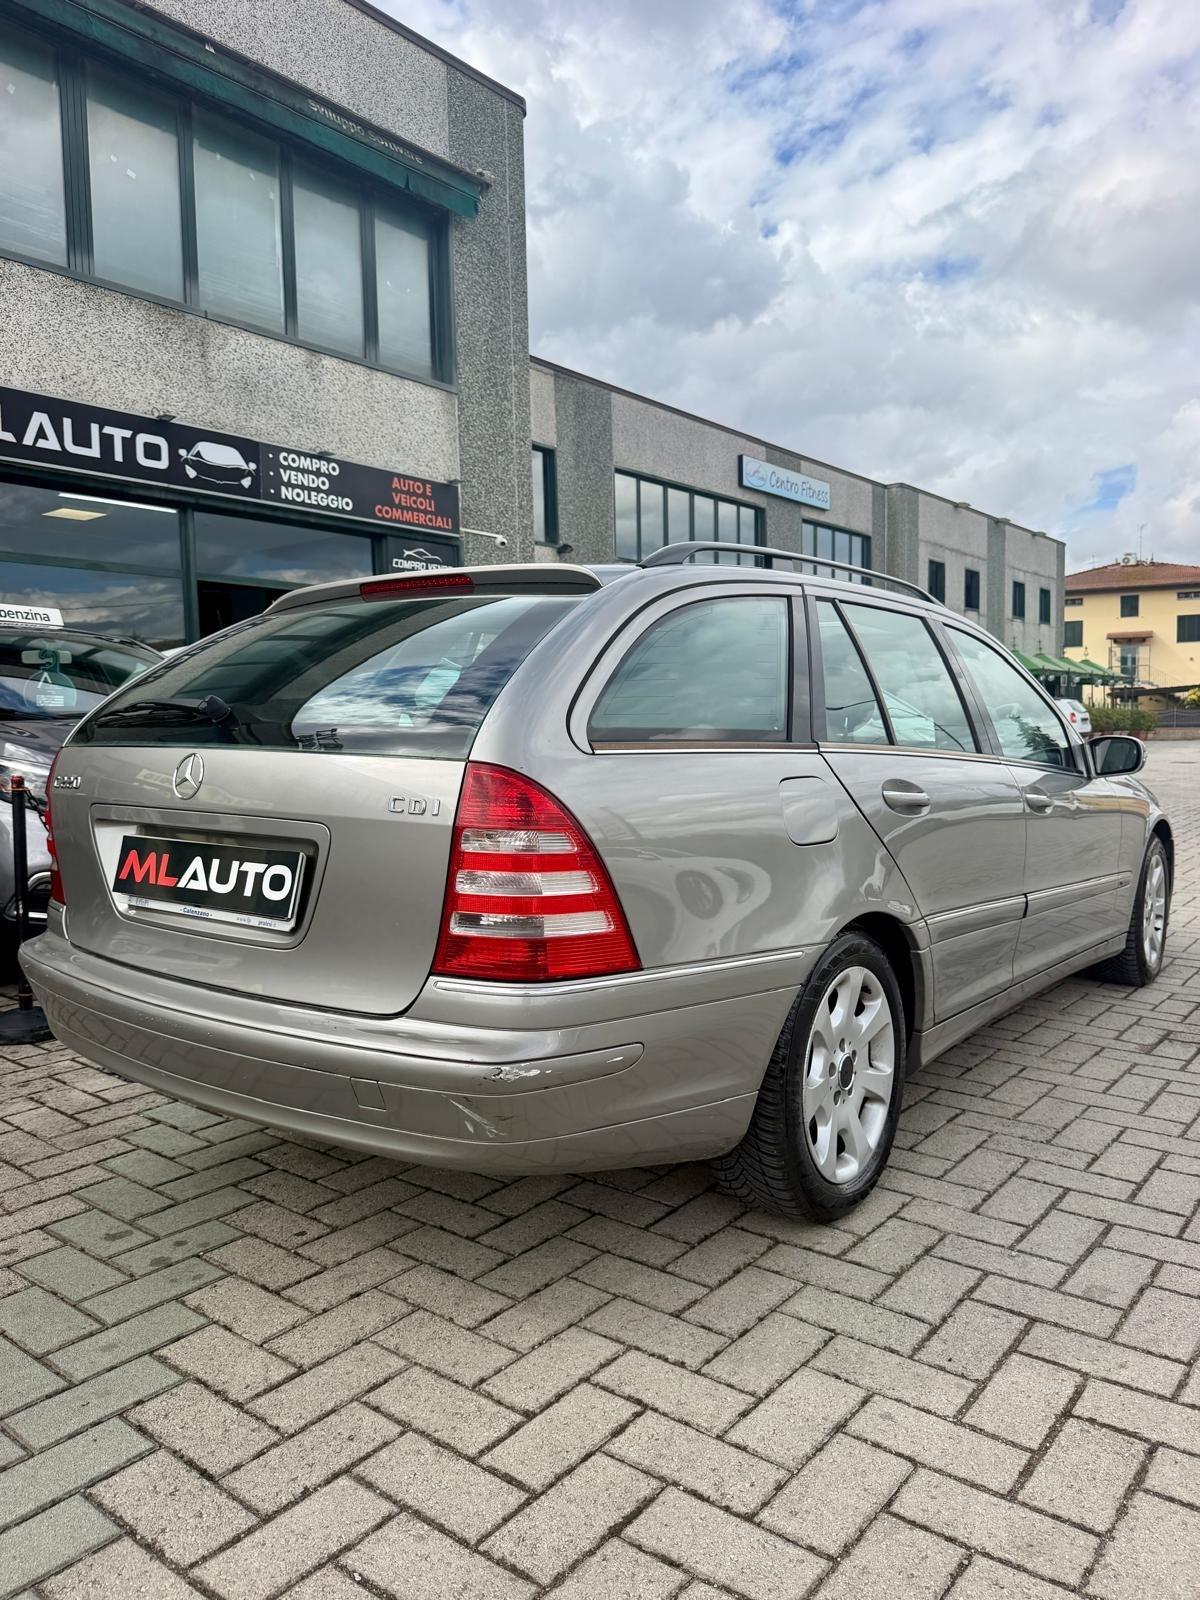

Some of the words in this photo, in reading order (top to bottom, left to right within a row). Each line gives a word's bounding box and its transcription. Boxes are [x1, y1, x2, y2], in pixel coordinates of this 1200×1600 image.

[279, 452, 340, 476] COMPRO
[279, 469, 330, 490] VENDO
[392, 477, 424, 495] AUTO
[426, 484, 432, 496] E
[769, 470, 800, 495] Centro
[801, 481, 829, 504] Fitness
[280, 486, 354, 511] NOLEGGIO
[392, 492, 435, 512] VEICOLI
[375, 505, 452, 530] COMMERCIALI
[392, 558, 427, 571] COMPRO
[388, 796, 441, 816] CDI
[119, 850, 292, 901] MLAUTO
